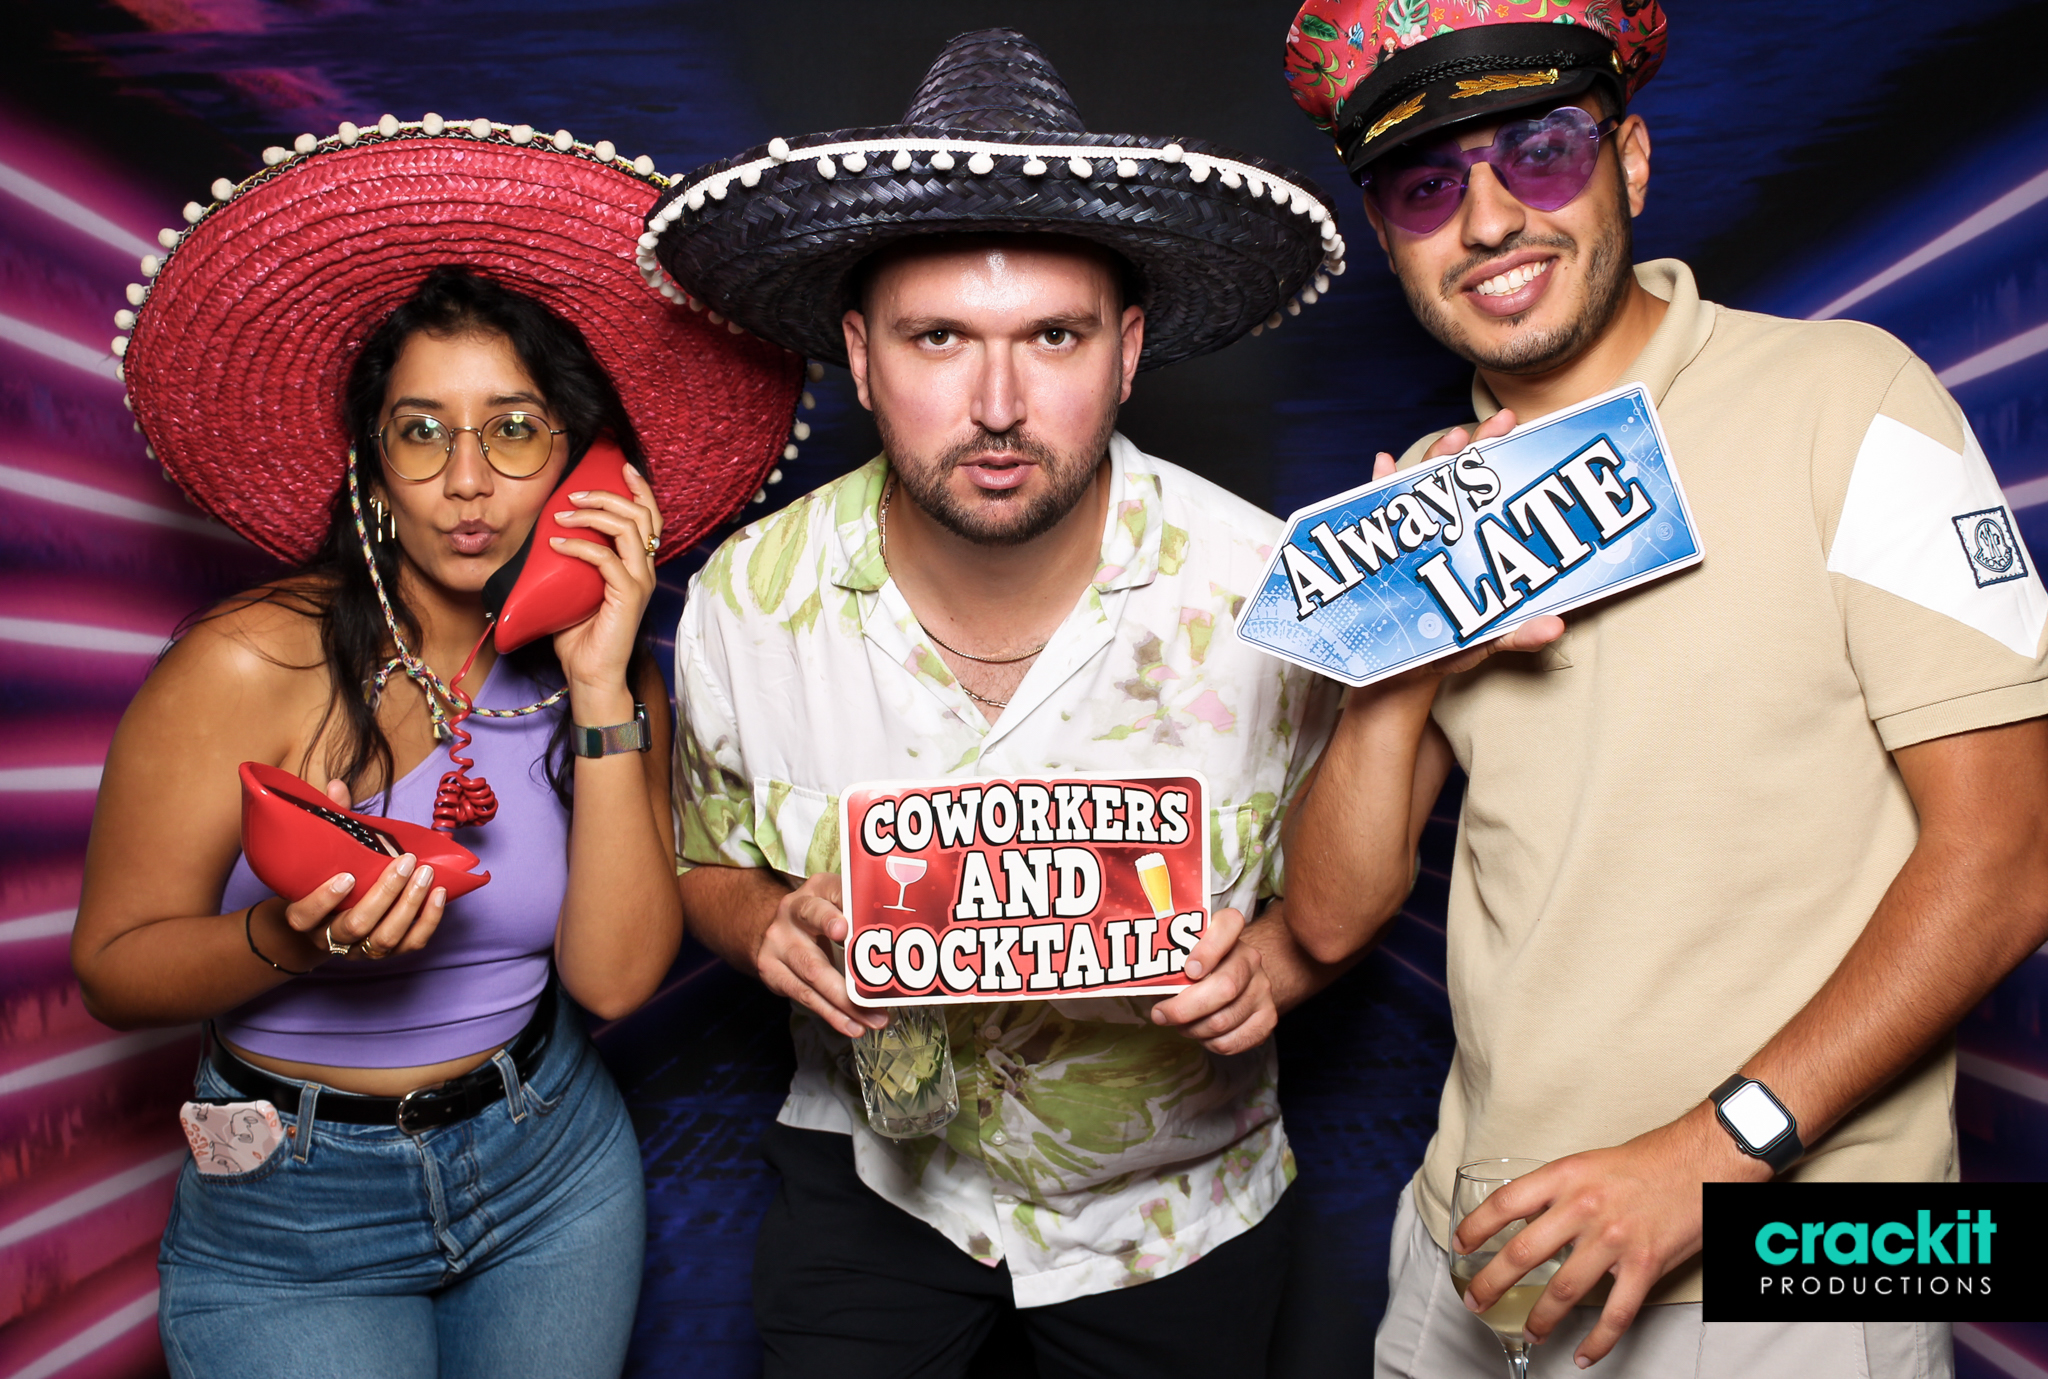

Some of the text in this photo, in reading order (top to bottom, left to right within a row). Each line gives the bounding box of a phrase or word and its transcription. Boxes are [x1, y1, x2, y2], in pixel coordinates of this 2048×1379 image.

[1282, 447, 1501, 621] Always
[1416, 438, 1653, 644] LATE
[862, 784, 1190, 854] COWORKERS
[953, 847, 1102, 921] AND
[852, 911, 1203, 992] COCKTAILS
